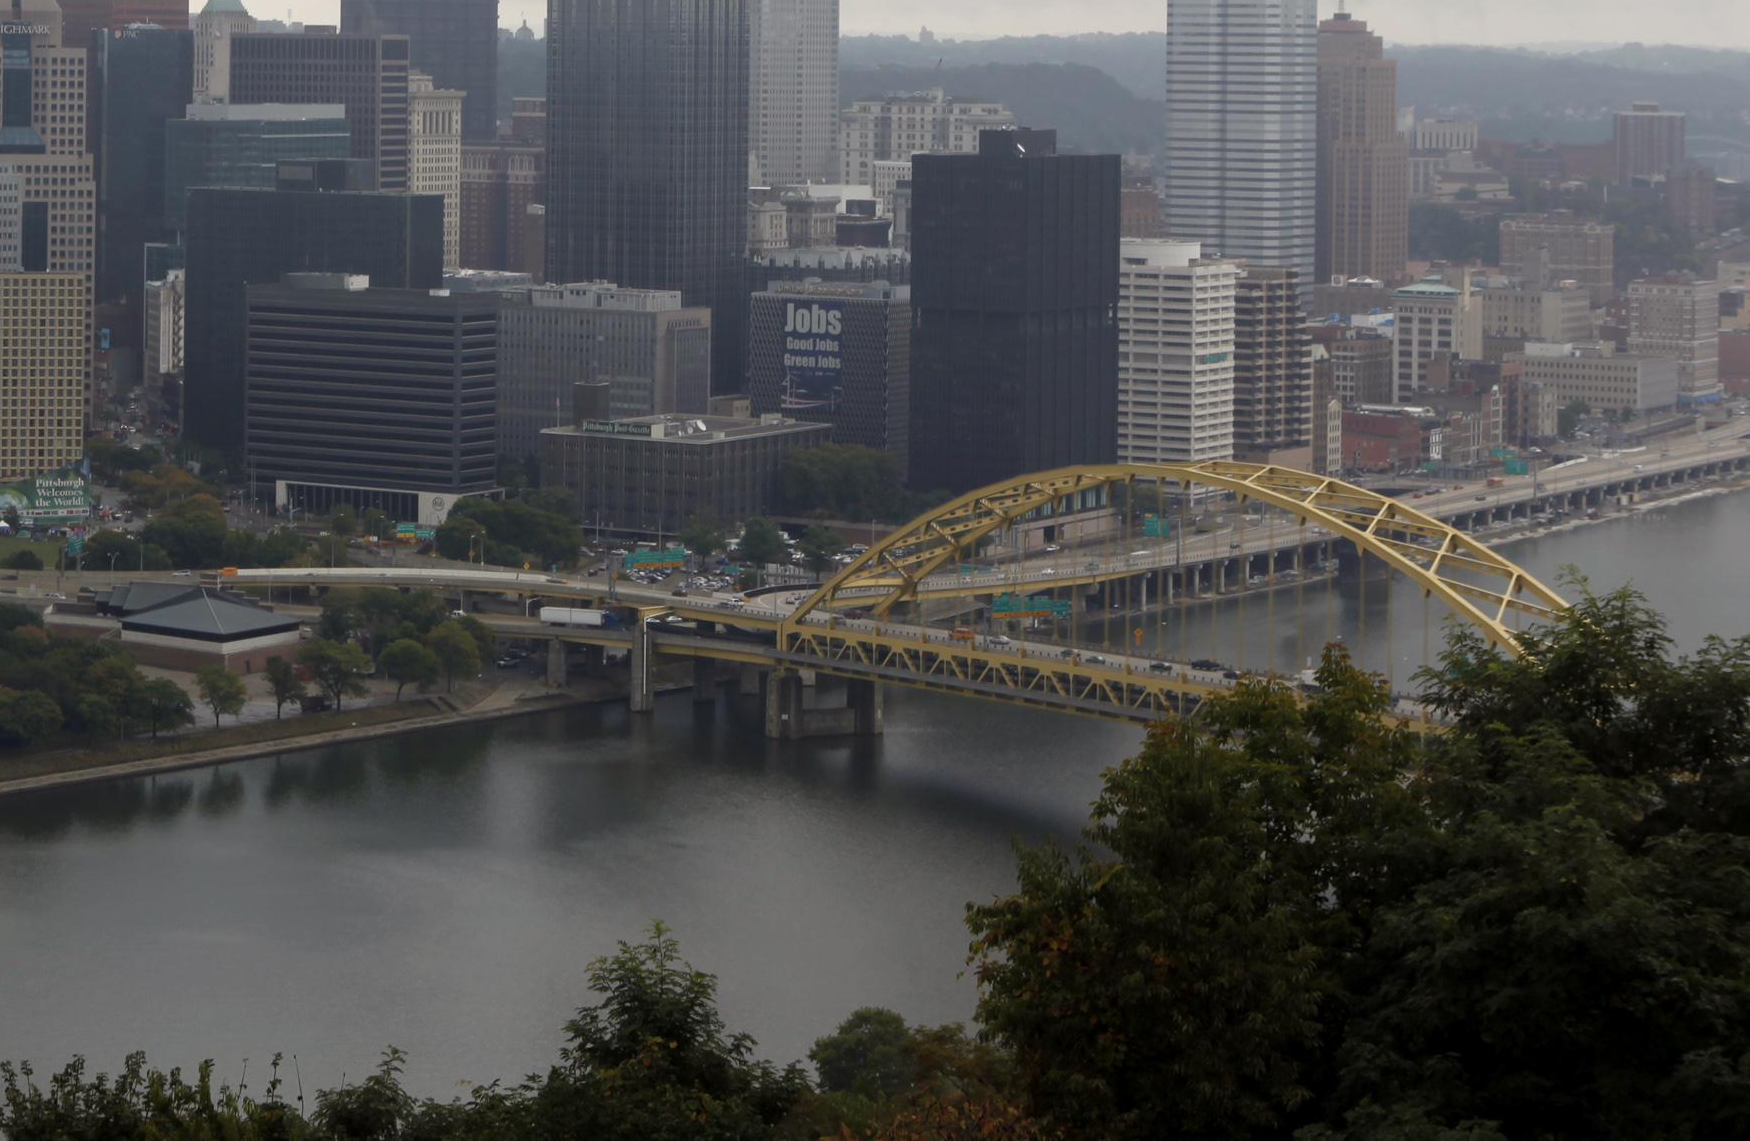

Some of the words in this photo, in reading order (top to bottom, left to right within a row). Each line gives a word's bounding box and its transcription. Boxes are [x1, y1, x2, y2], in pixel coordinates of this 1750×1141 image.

[123, 30, 139, 38] PNC
[784, 303, 842, 335] Jobs
[787, 337, 813, 350] Good
[815, 338, 839, 352] Jobs
[784, 353, 816, 367] Green
[817, 355, 841, 369] Jobs
[36, 478, 84, 489] Pittsburgh
[37, 488, 83, 497] Welcomes
[36, 498, 50, 506] the
[54, 497, 83, 506] World!
